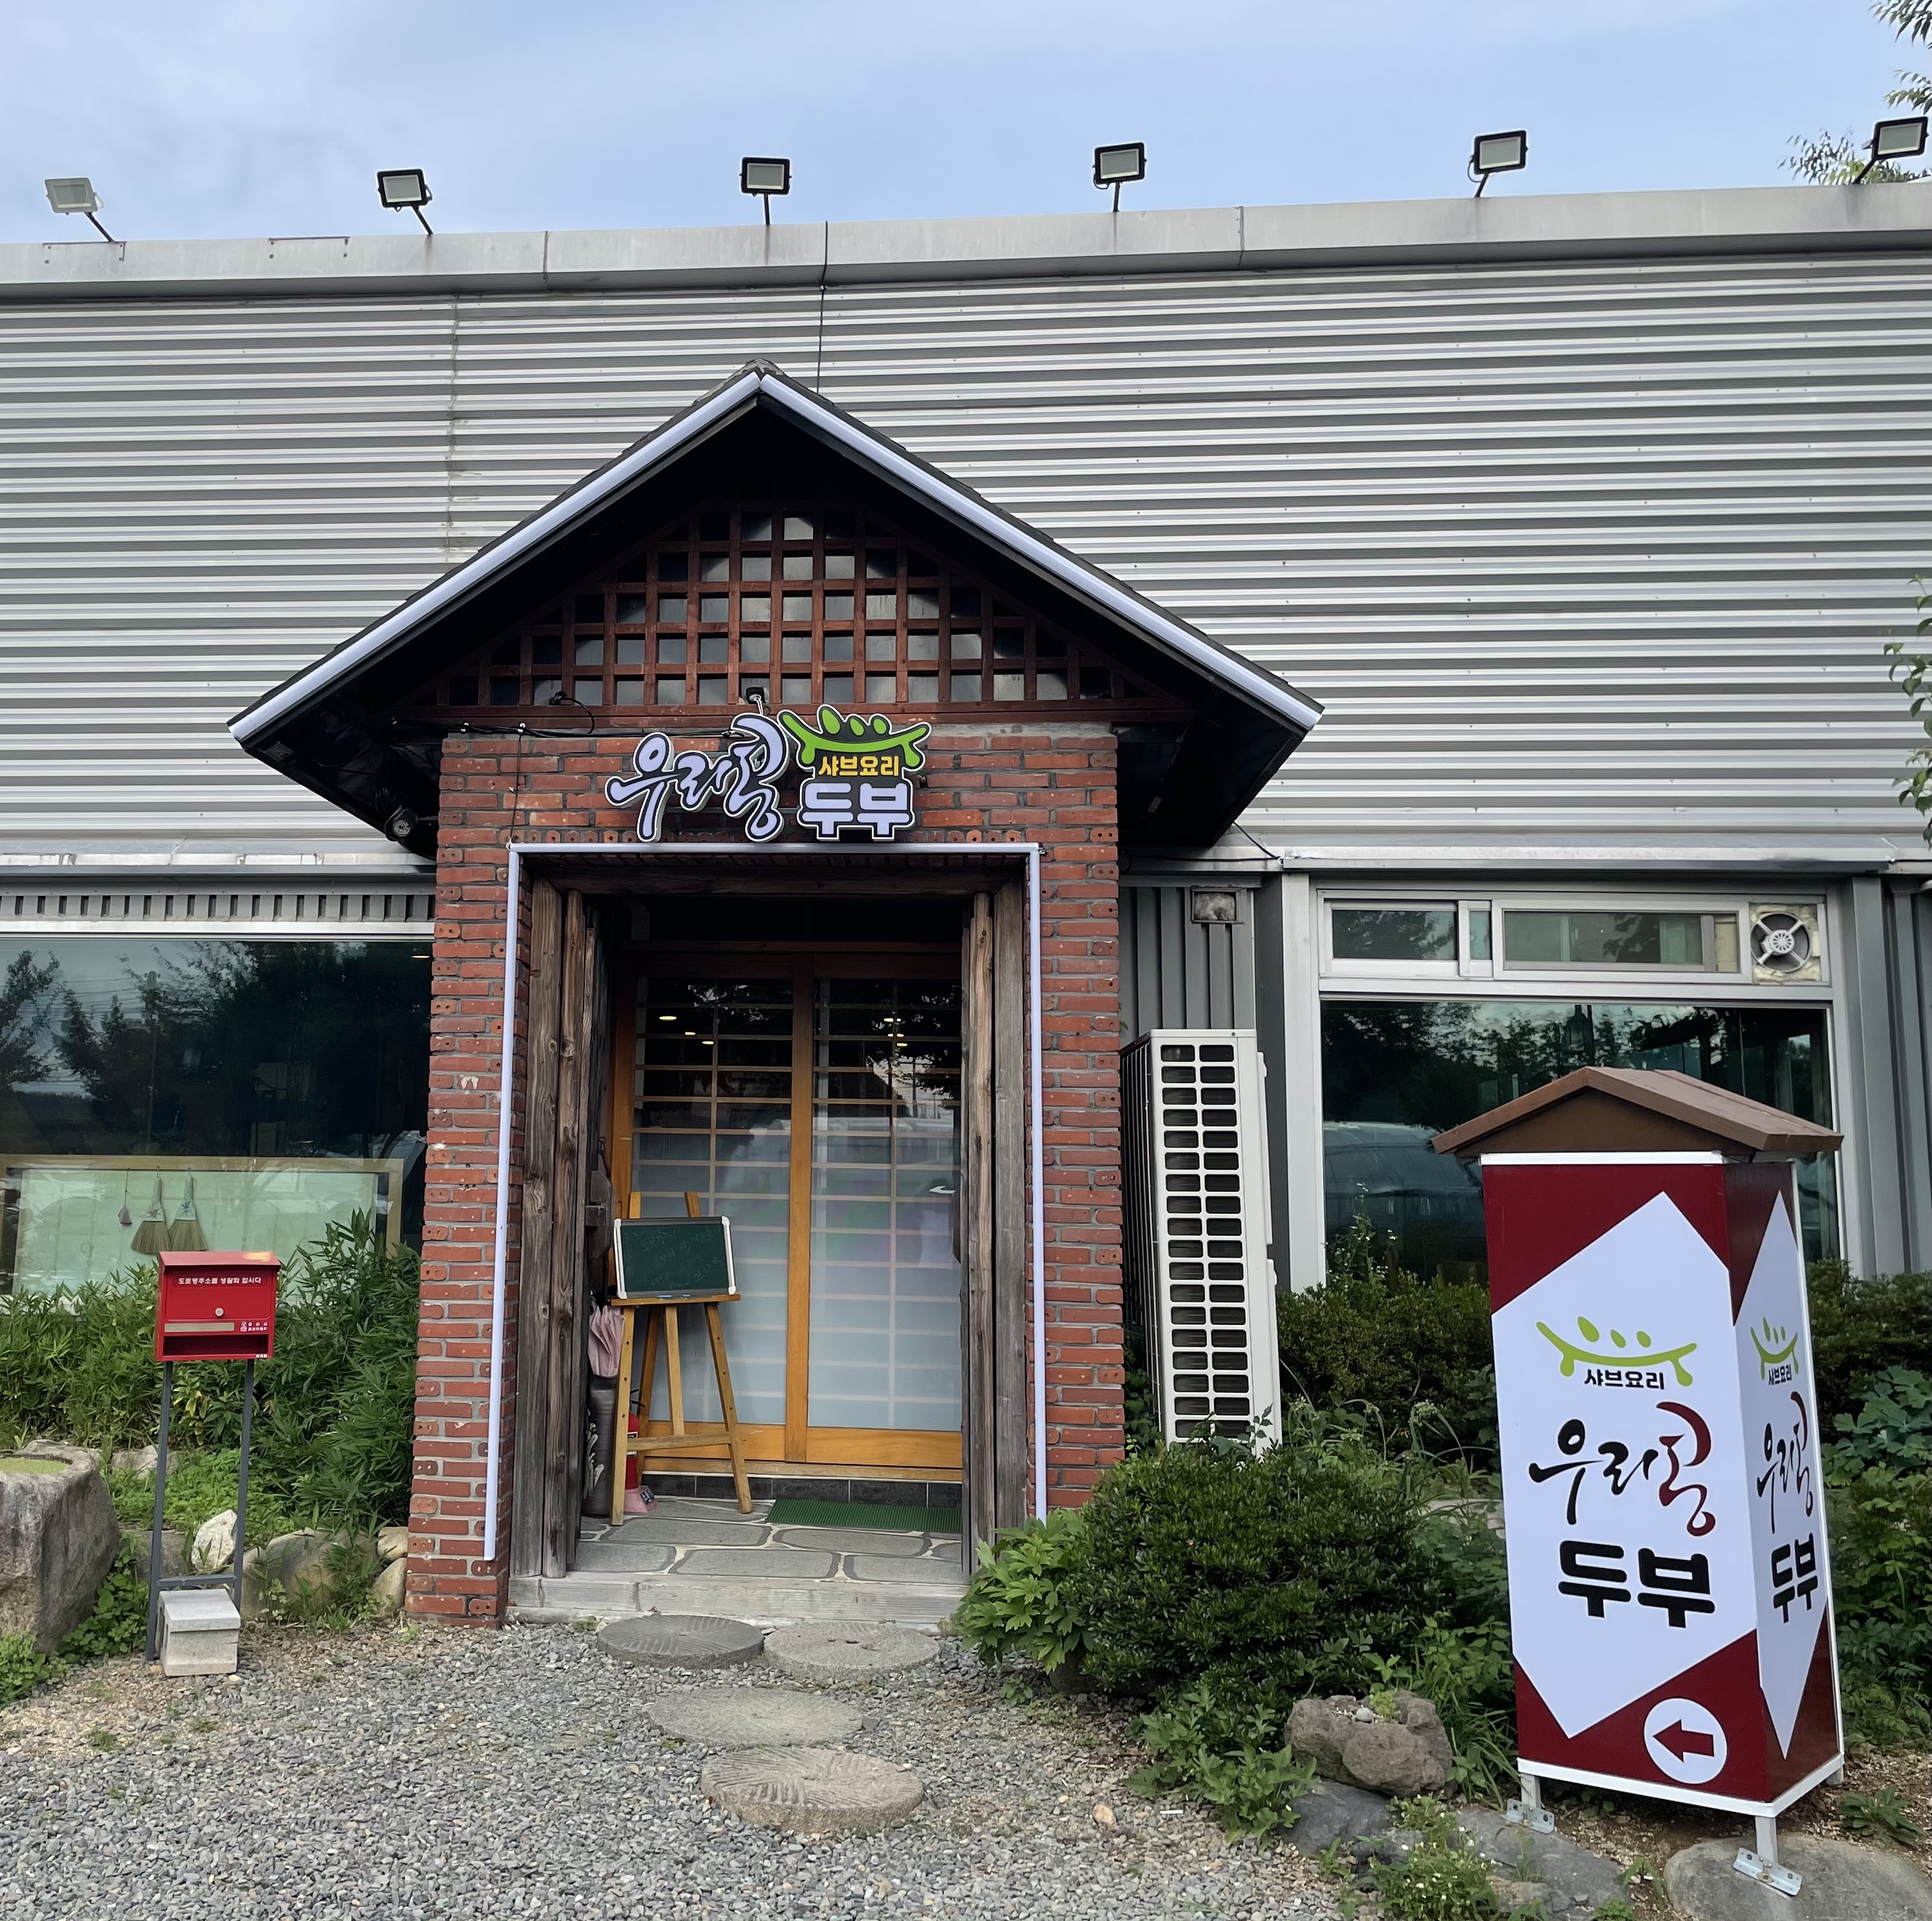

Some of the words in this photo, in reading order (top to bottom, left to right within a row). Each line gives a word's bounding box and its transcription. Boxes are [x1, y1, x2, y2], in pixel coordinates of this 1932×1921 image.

[606, 714, 788, 841] 우리콩
[802, 783, 912, 835] 두부
[818, 756, 899, 777] 샤브요리
[1584, 1369, 1664, 1389] 샤브요리
[1768, 1364, 1792, 1385] 샤브요리
[1528, 1401, 1716, 1536] 우리콩
[1757, 1391, 1813, 1533] 우리콩
[1558, 1541, 1715, 1629] 두부
[1771, 1533, 1818, 1623] 두부
